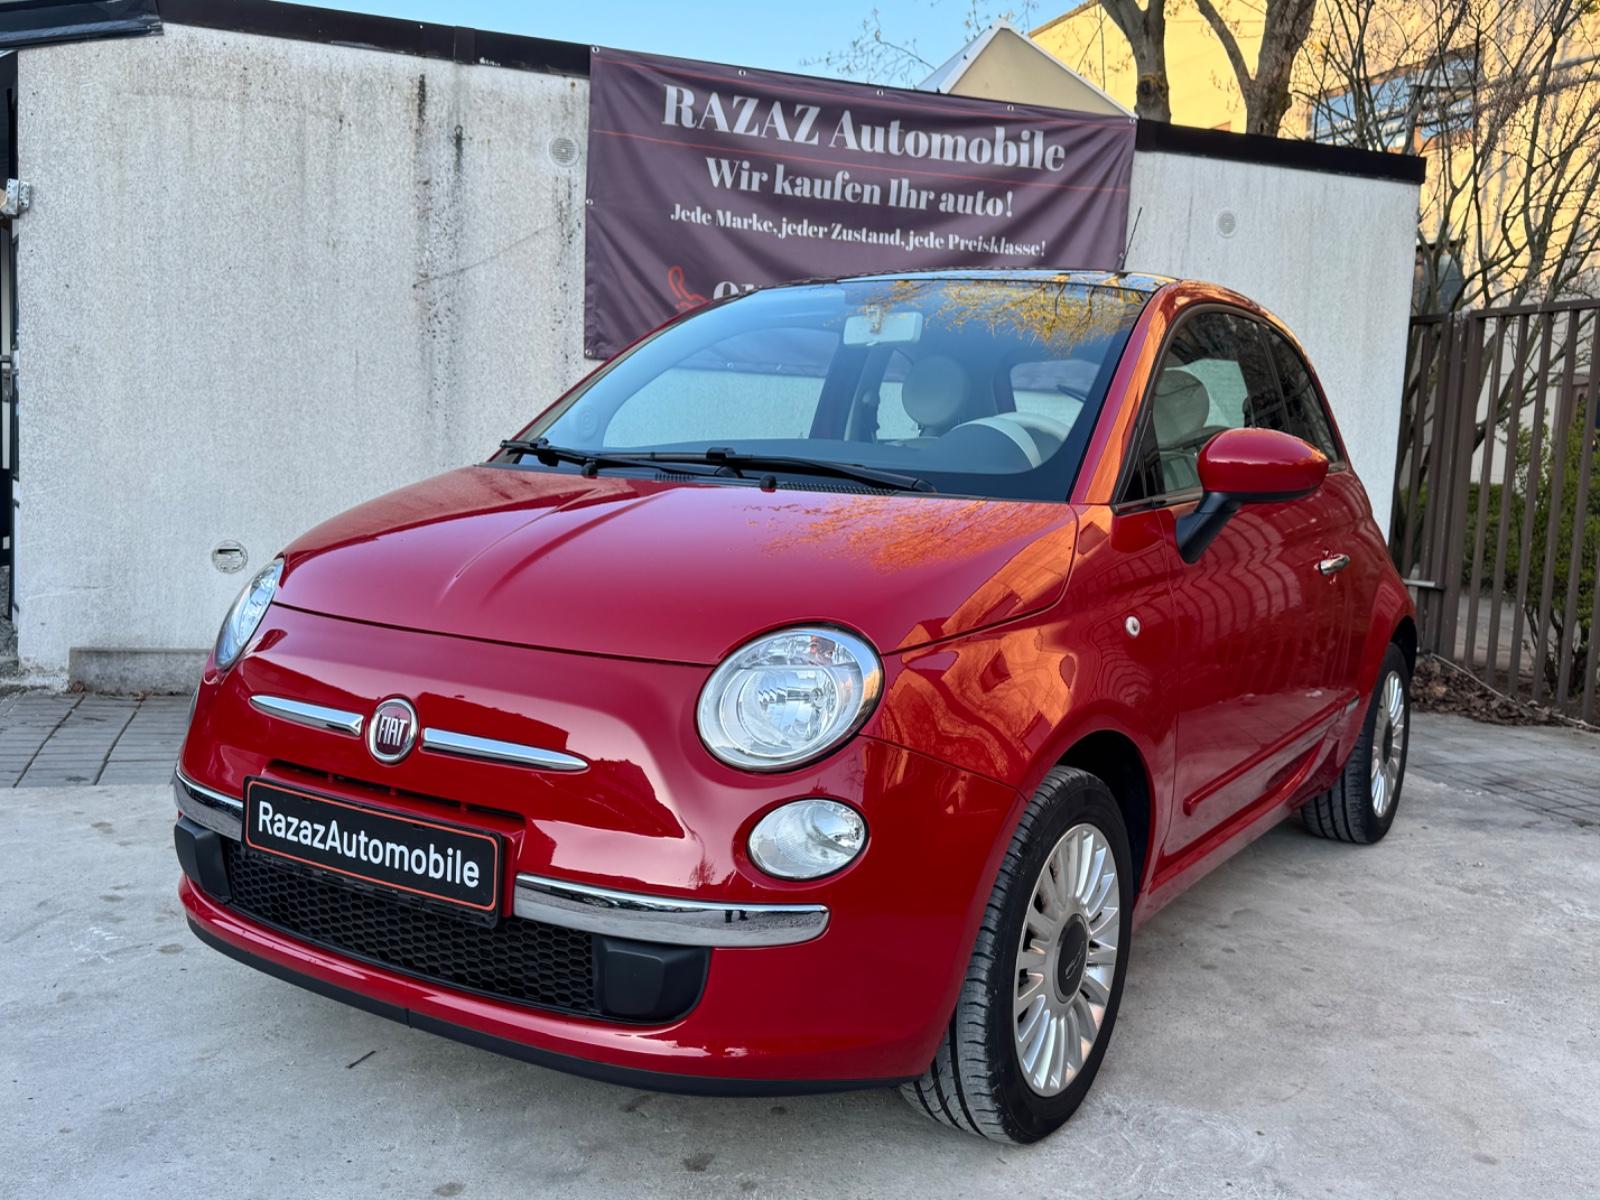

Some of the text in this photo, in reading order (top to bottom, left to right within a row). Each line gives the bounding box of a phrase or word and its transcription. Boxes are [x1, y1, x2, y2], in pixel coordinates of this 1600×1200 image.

[661, 83, 1065, 171] RAZAZ Automobile
[705, 156, 1014, 218] Wir kaufen Ihr auto!
[670, 203, 713, 226] Jede
[948, 234, 1047, 257] Preisklasse!
[377, 716, 408, 746] FIAT
[258, 801, 480, 888] RazazAutomobile
